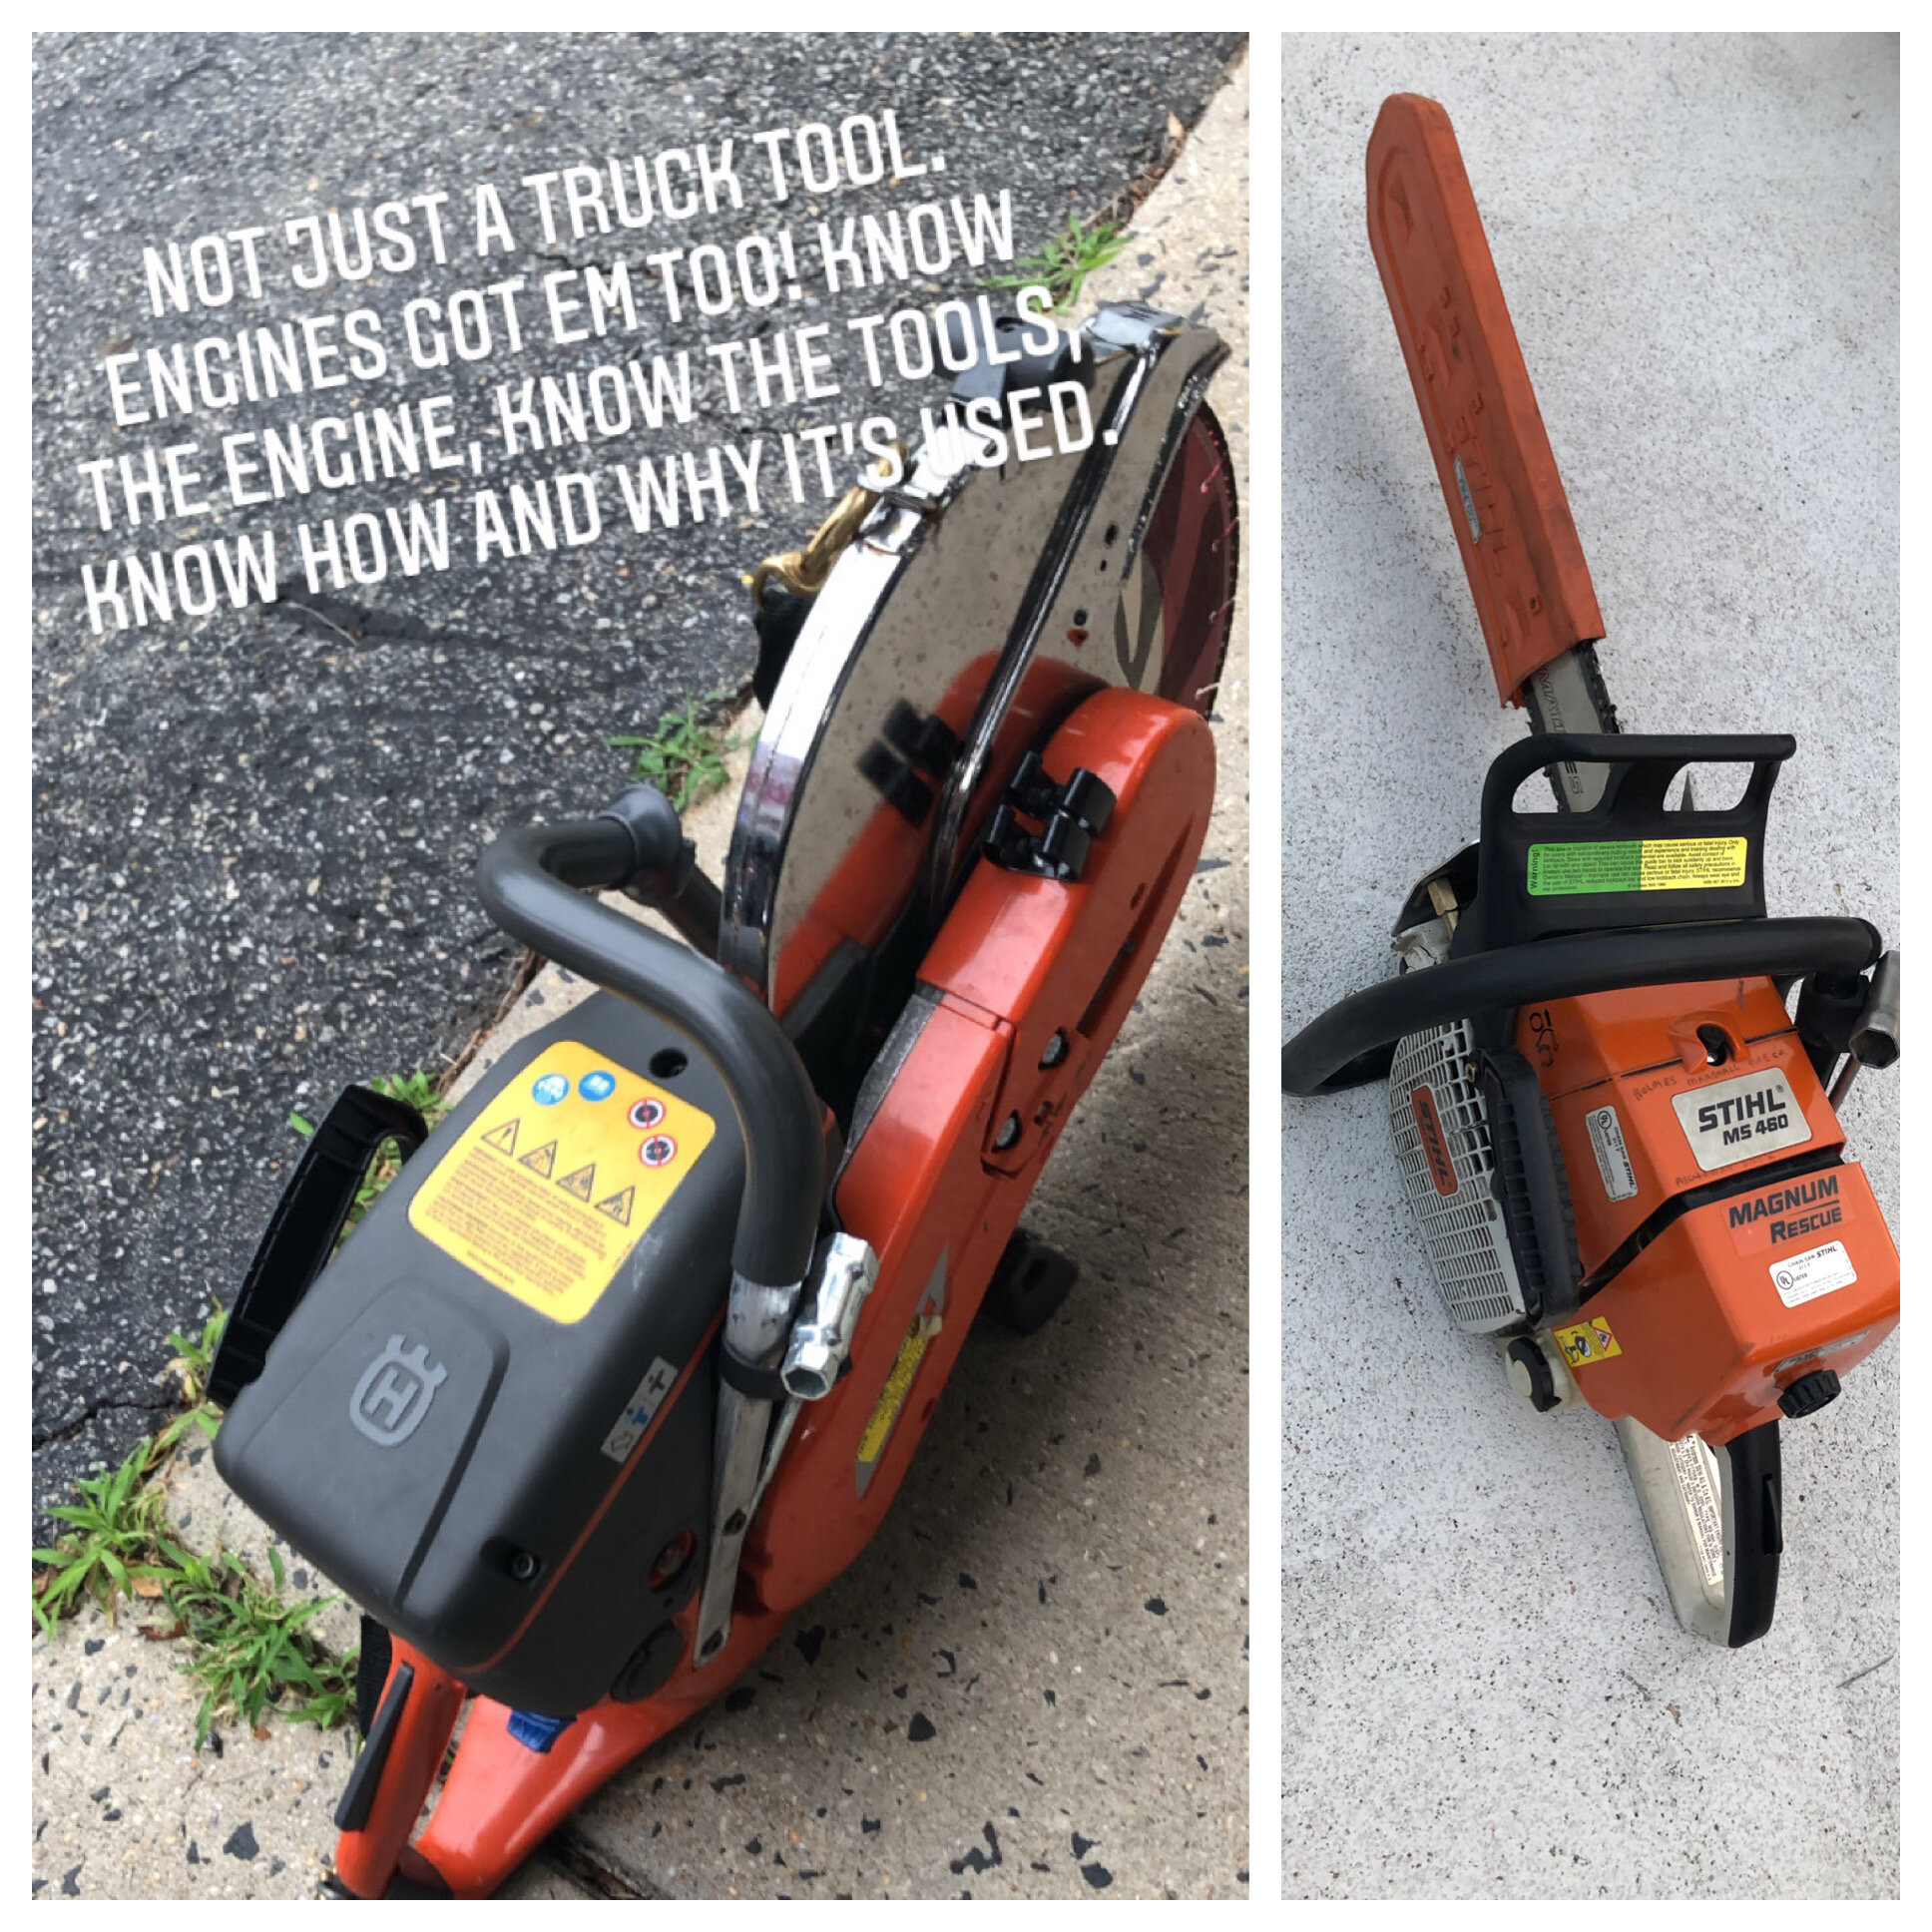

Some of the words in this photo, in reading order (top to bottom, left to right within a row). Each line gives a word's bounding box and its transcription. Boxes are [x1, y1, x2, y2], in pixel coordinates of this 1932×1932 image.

[1530, 849, 1540, 889] Warning!
[1698, 1088, 1786, 1134] STIHL
[1722, 1124, 1752, 1146] MS
[1755, 1113, 1788, 1135] 460
[1419, 1099, 1449, 1187] STIHL
[1623, 1161, 1636, 1189] STIHL
[1728, 1174, 1838, 1229] MAGNUM
[1816, 1244, 1838, 1258] STIHL
